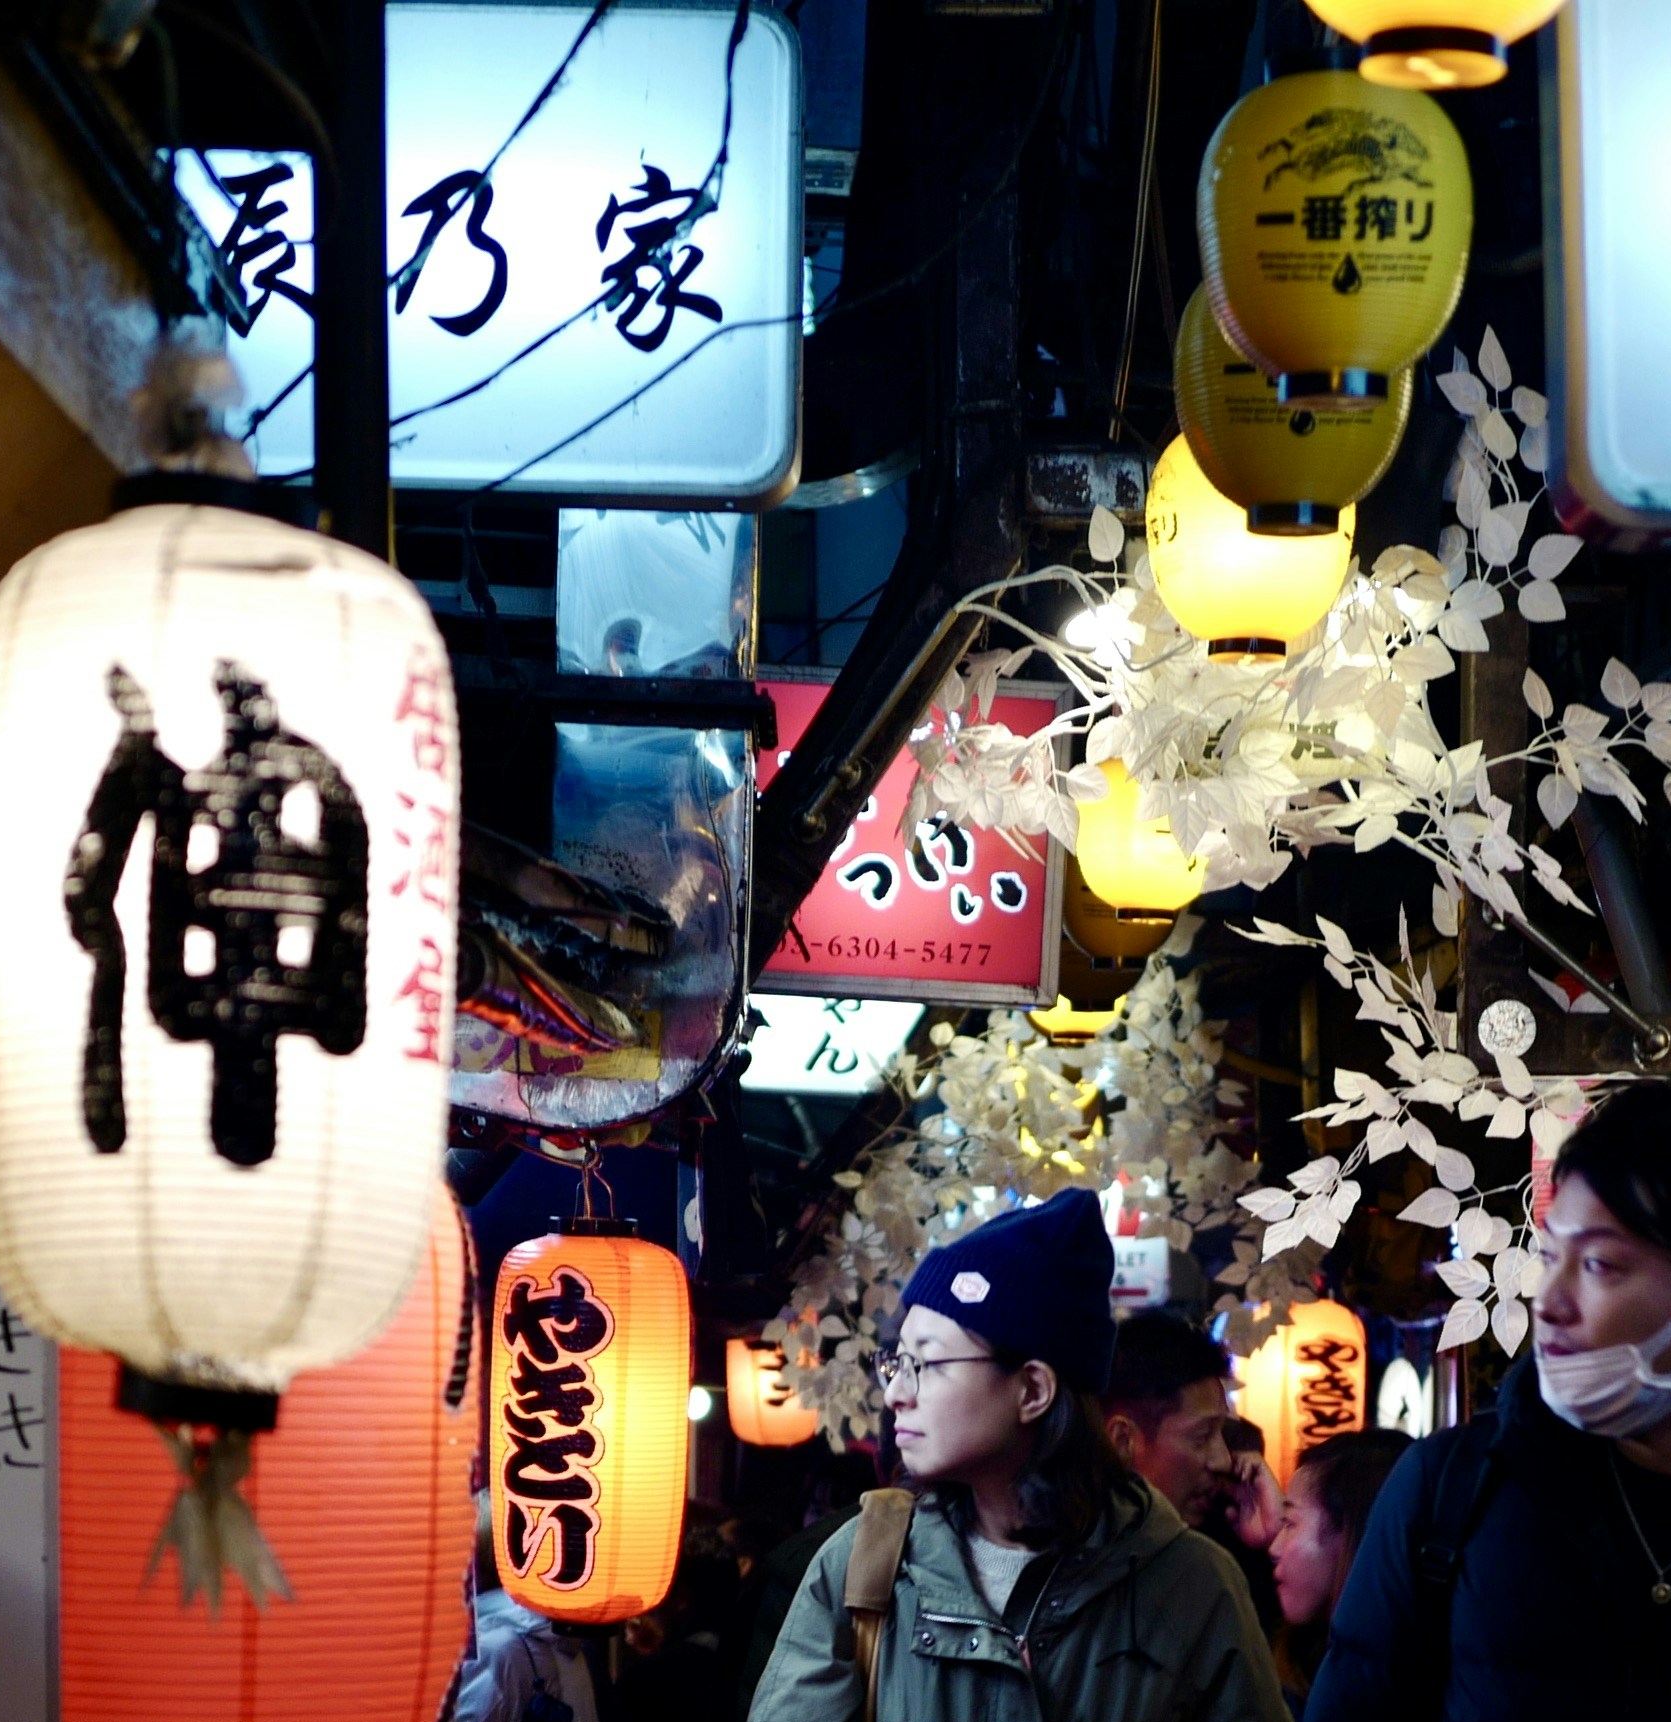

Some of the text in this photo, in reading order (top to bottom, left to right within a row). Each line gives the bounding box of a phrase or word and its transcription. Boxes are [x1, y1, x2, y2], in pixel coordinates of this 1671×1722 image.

[1256, 195, 1434, 242] 一番搾り
[504, 1266, 614, 1591] やきとり
